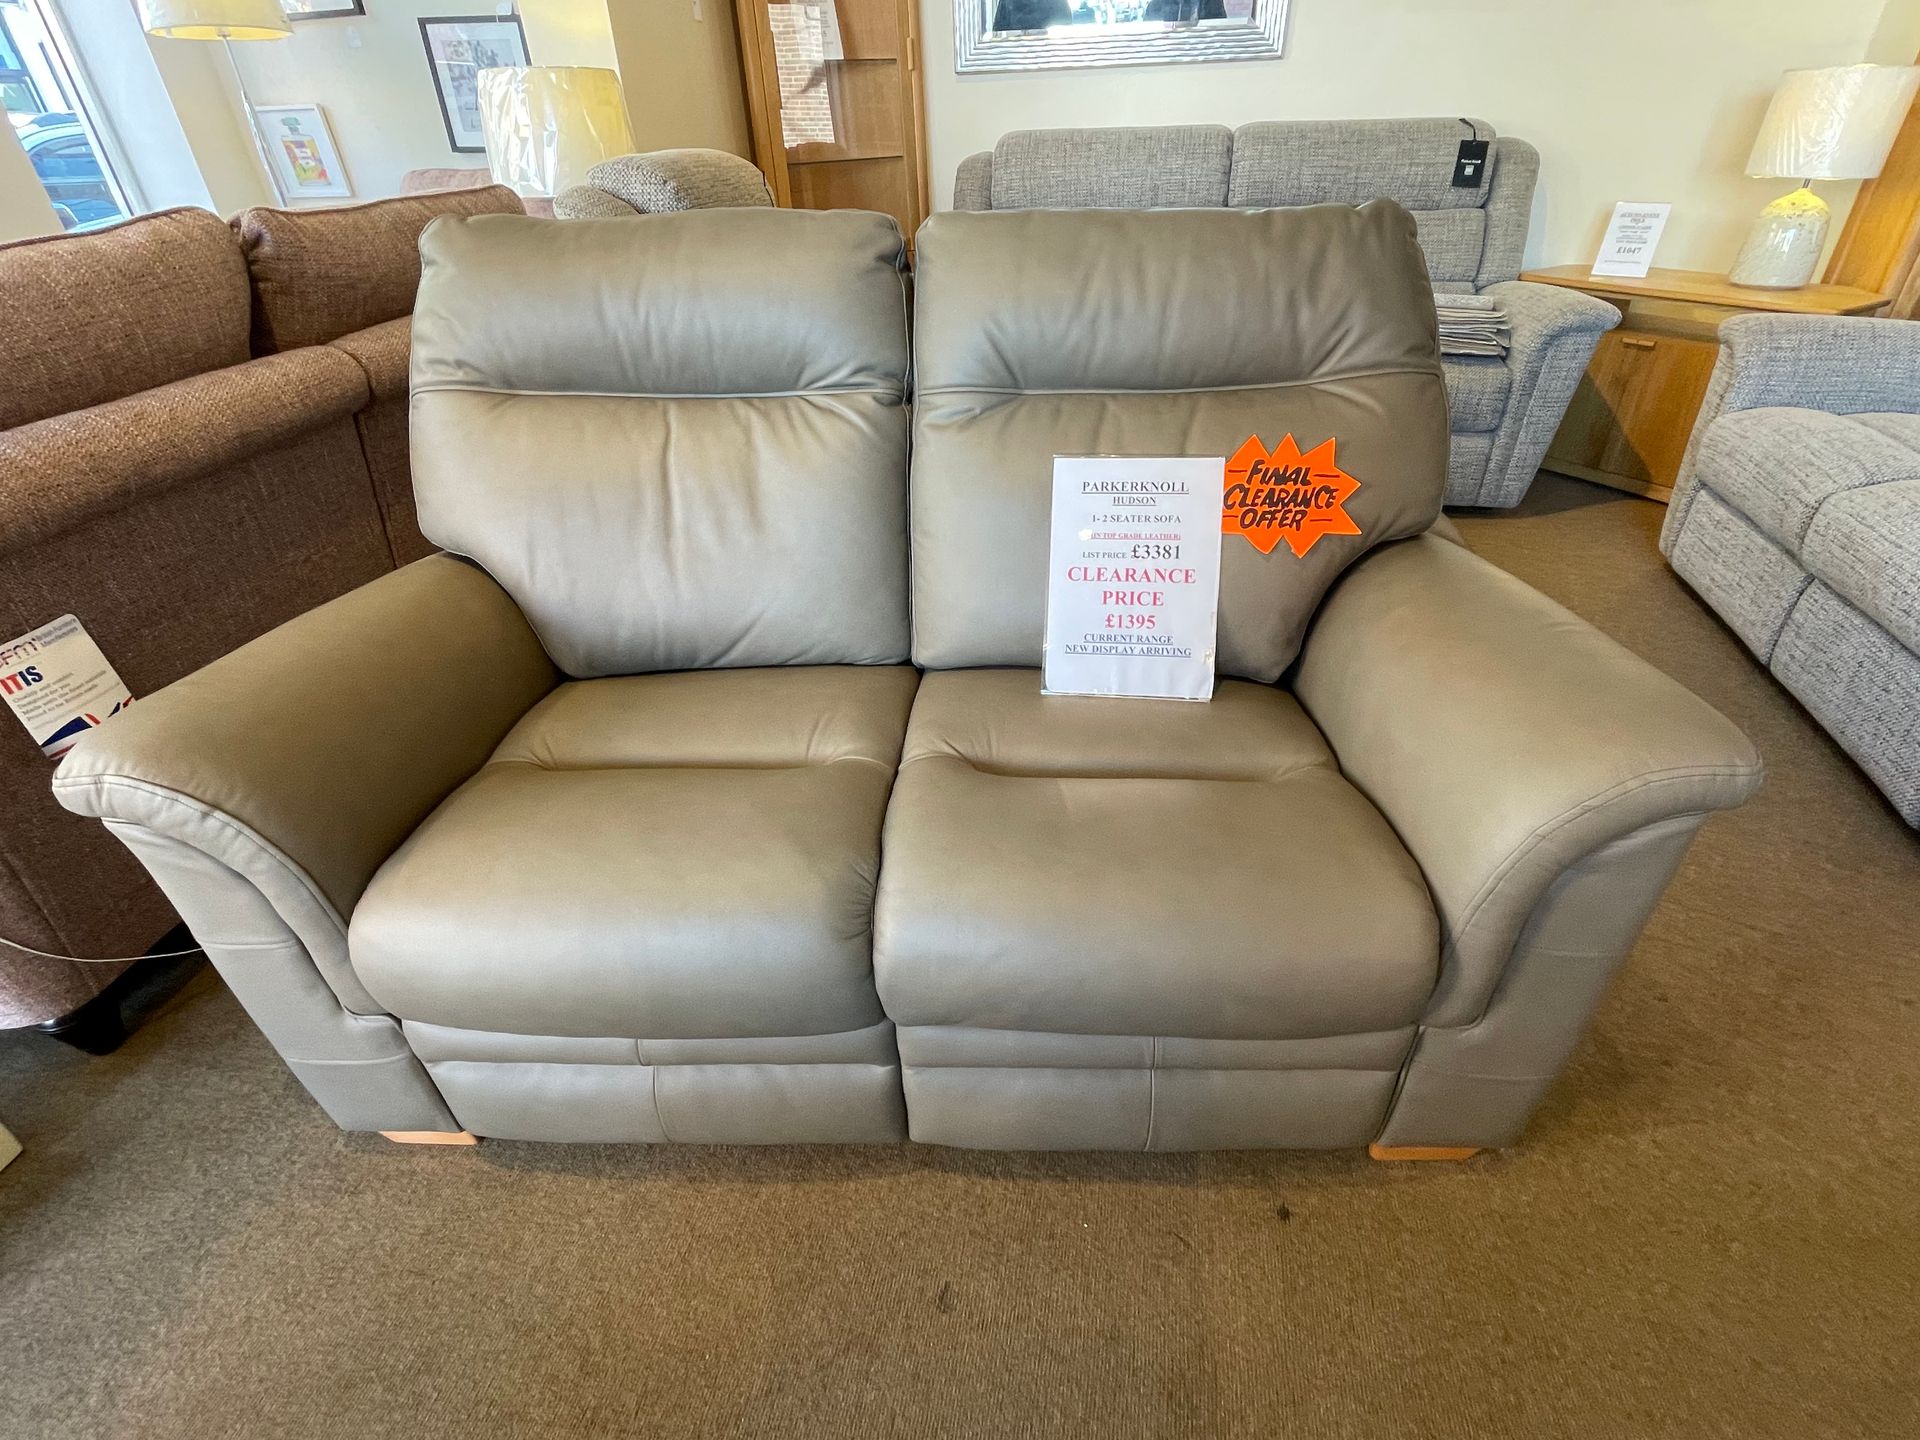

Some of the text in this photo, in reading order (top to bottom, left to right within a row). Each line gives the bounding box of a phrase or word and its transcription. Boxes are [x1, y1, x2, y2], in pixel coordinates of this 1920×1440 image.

[1246, 459, 1313, 486] FINAL
[1082, 481, 1189, 494] PARKERKNOLL
[1112, 496, 1157, 506] HUDSON
[1223, 483, 1340, 510] CLEARANCE
[1110, 515, 1151, 524] SEATER
[1154, 515, 1182, 524] SOFA
[1240, 508, 1308, 532] OFFER
[1103, 532, 1117, 540] TOP
[1118, 532, 1143, 540] GRADE
[1082, 544, 1181, 560] LIST PRICE £3381
[1067, 566, 1197, 584] CLEARANCE
[1102, 590, 1165, 607] PRICE
[1105, 613, 1157, 630] £1395
[1083, 633, 1174, 645] CURRENT RANGE
[1065, 644, 1192, 657] NEW DISPLAY ARRIVING
